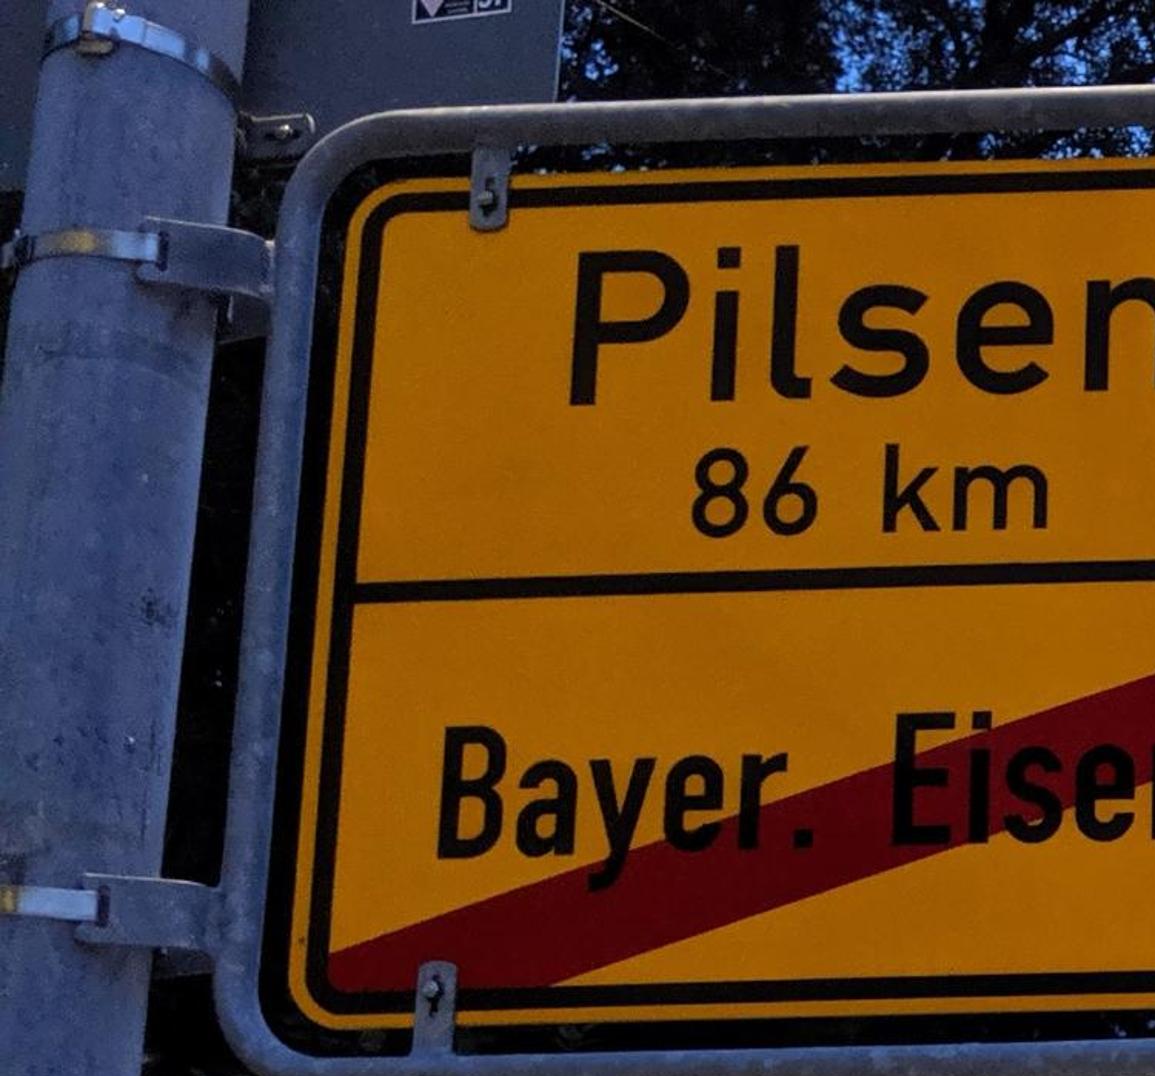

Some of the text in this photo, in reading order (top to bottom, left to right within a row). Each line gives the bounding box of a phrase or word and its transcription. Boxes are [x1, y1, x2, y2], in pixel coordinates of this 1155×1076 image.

[692, 443, 1048, 539] 86 km
[437, 725, 812, 892] Bayer.
